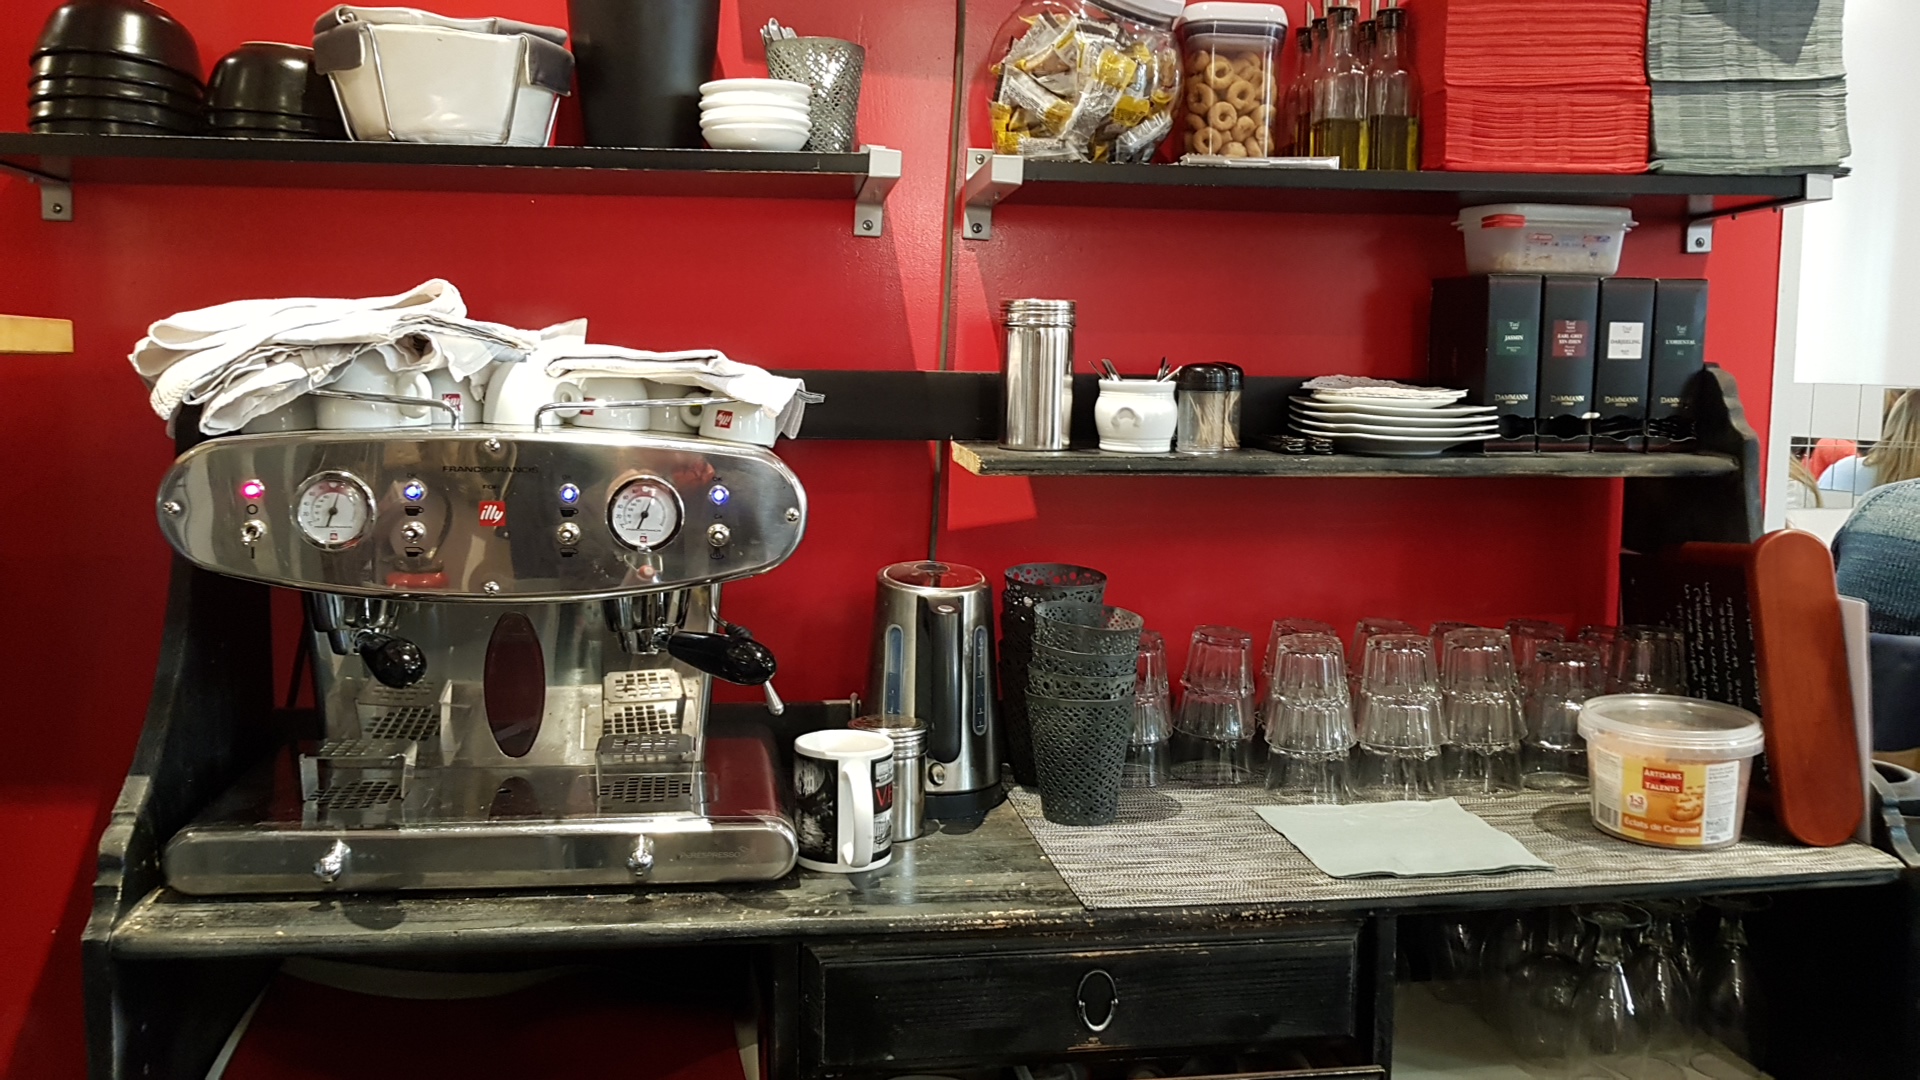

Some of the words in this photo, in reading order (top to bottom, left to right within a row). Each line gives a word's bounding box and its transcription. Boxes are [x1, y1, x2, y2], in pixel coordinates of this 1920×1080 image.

[1504, 334, 1524, 342] JASMIN
[479, 504, 504, 523] illy
[1644, 769, 1683, 780] ARTISANS
[1644, 781, 1680, 793] TALENTS
[1663, 825, 1700, 834] Caramel
